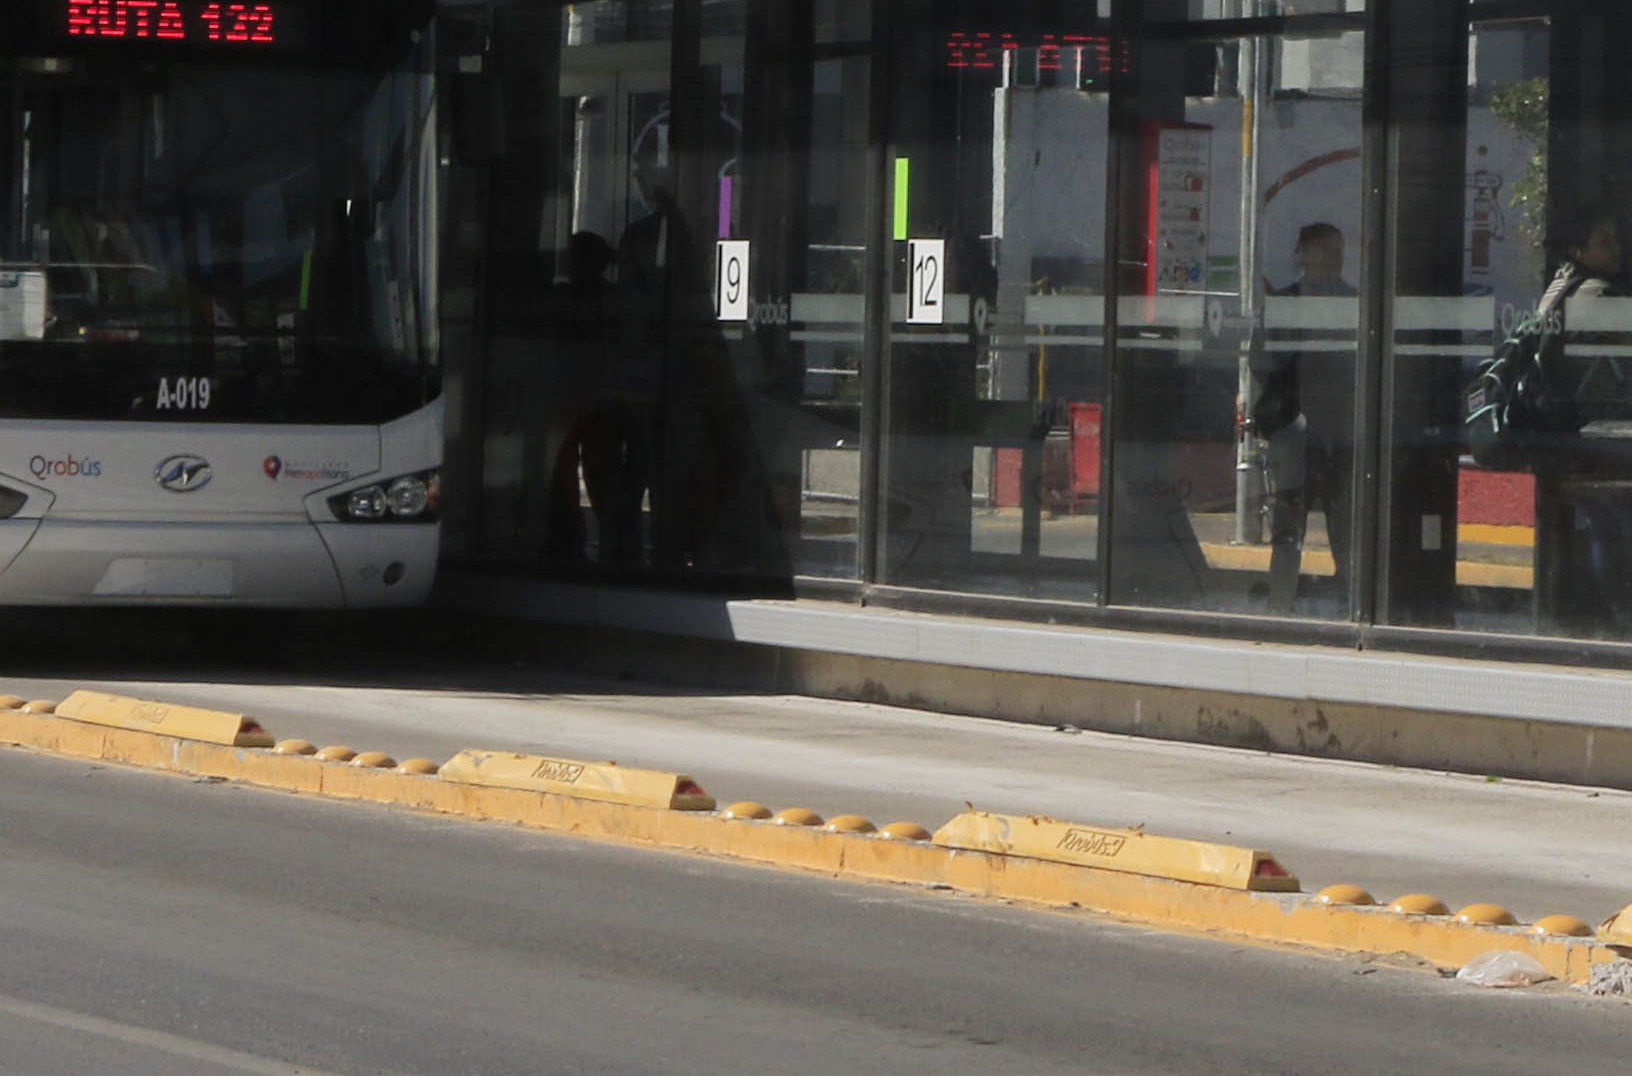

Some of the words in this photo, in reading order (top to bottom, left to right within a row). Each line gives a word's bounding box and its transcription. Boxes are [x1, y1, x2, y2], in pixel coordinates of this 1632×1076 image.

[200, 4, 274, 42] 122
[727, 256, 741, 304] 9
[916, 255, 939, 306] 12
[156, 376, 211, 410] A-019
[29, 454, 102, 480] Qrobús
